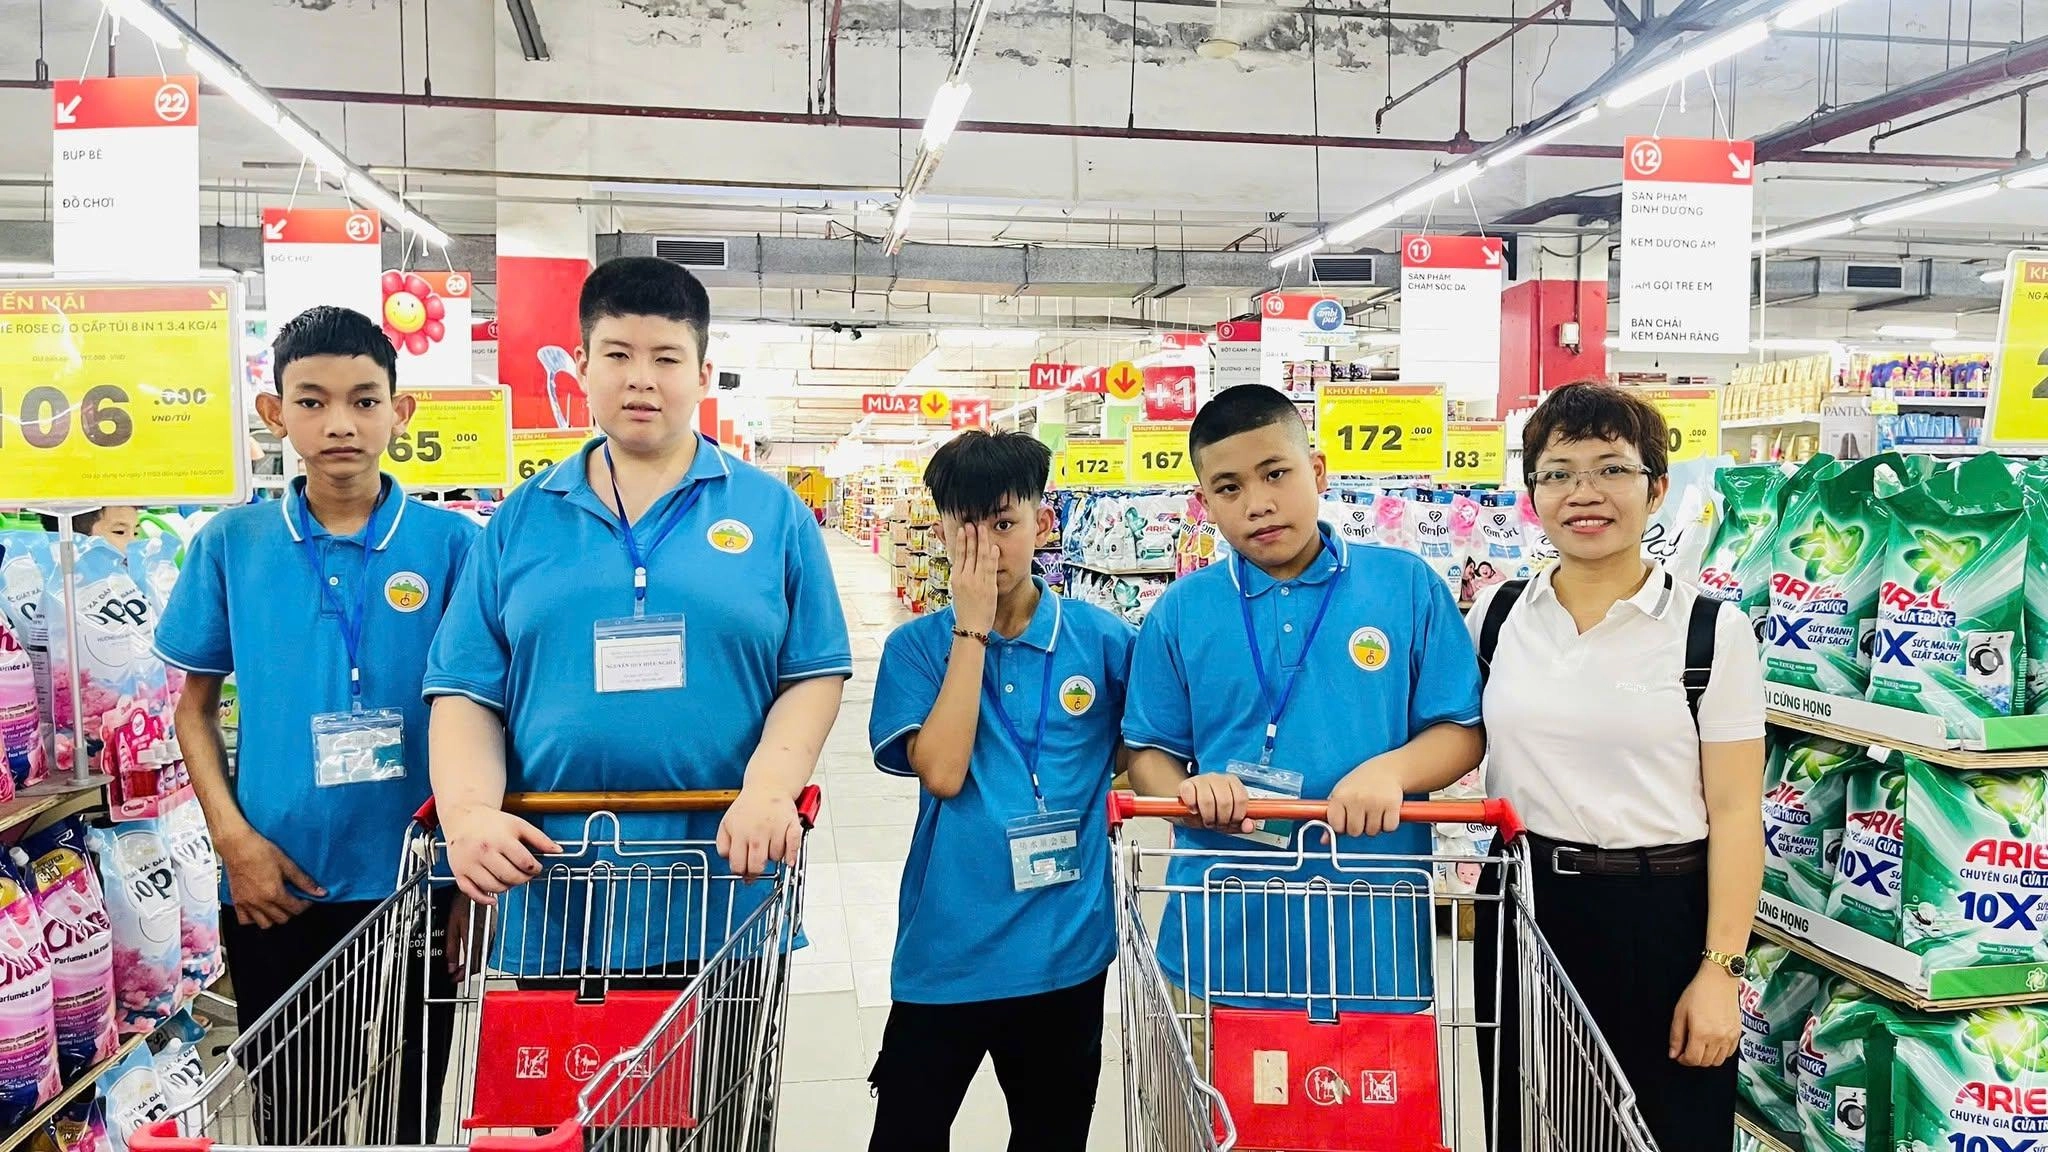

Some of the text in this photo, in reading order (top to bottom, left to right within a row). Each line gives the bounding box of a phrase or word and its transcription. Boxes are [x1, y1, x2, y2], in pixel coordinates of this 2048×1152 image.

[159, 93, 185, 112] 22
[1635, 149, 1657, 167] 12
[350, 222, 370, 236] 21
[1411, 243, 1428, 257] 11
[448, 280, 463, 291] 20
[42, 292, 85, 310] MÃI
[1268, 299, 1283, 310] 10
[16, 322, 49, 333] ROSE
[131, 321, 139, 332] 8
[141, 321, 155, 332] IN
[167, 320, 185, 331] 3.4
[188, 319, 218, 332] KG/4
[1321, 314, 1338, 326] pur
[1036, 367, 1101, 388] MUA 1
[1150, 376, 1193, 413] +1
[1326, 386, 1369, 395] KHUYẾN
[867, 397, 919, 412] MUA 2
[1823, 405, 1871, 417] PANTEN
[0, 384, 134, 449] 06
[954, 404, 989, 430] +1
[1337, 425, 1433, 451] 172 .000
[1689, 429, 1707, 437] .000
[387, 430, 478, 463] 65 .000
[1076, 459, 1109, 473] 172
[1142, 451, 1184, 470] 167
[1418, 493, 1429, 503] 3L
[1482, 499, 1494, 507] 3L
[1483, 525, 1520, 539] Comort
[1803, 698, 1832, 718] HỌNG
[1960, 868, 2000, 883] CHUYÊN
[2002, 873, 2019, 885] GIA
[1957, 890, 2043, 931] 10X
[1780, 911, 1809, 934] HỌNG
[0, 991, 29, 1003] arfumée
[1955, 1082, 2048, 1115] ARIE
[1949, 1109, 1990, 1127] CHUYÊN
[1992, 1118, 2010, 1130] GIA
